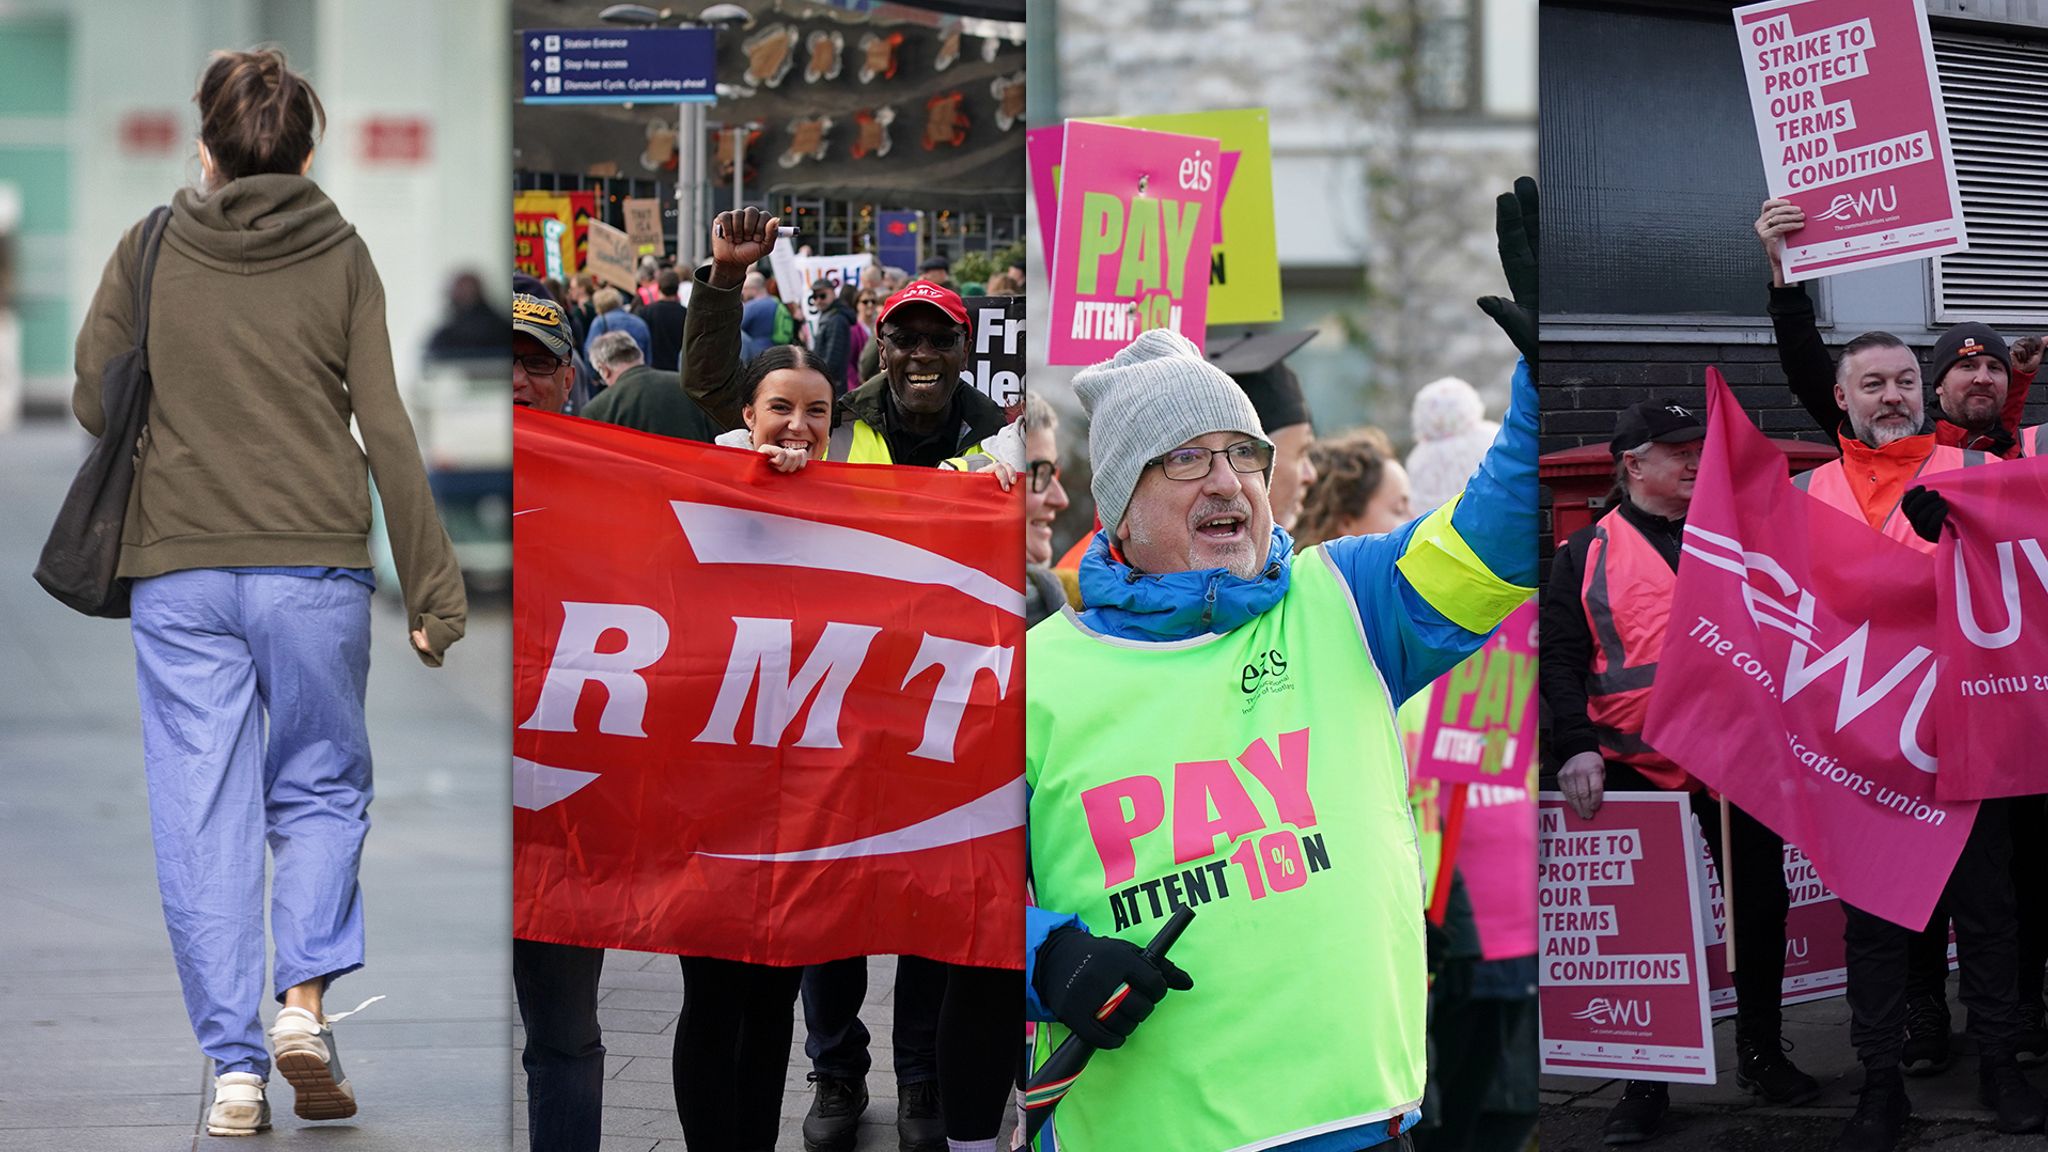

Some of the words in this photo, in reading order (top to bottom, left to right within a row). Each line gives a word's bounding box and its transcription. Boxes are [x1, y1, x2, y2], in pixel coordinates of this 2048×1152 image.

[563, 37, 592, 49] Station
[593, 37, 628, 49] Entrance
[1752, 21, 1785, 46] ON
[1758, 34, 1831, 71] STRIKE
[1837, 26, 1865, 50] TO
[564, 78, 602, 90] Dismount
[628, 78, 650, 91] Cycle
[651, 78, 681, 91] parking
[682, 77, 707, 89] ahead
[1765, 52, 1859, 95] PROTECT
[1770, 90, 1816, 118] OUR
[1775, 107, 1846, 142] TERMS
[1782, 137, 1828, 166] AND
[1788, 137, 1924, 188] CONDITIONS
[1178, 150, 1212, 192] eis
[1829, 185, 1898, 221] CWU
[1076, 192, 1202, 300] PAY
[518, 601, 1015, 763] RMT
[1241, 650, 1287, 694] eis
[1442, 648, 1539, 735] PAY
[1689, 616, 1734, 656] The
[1876, 787, 1946, 826] union
[1081, 727, 1317, 889] PAY
[1606, 835, 1634, 855] TO
[1539, 887, 1583, 907] OUR
[1542, 911, 1610, 932] TERMS
[1545, 937, 1590, 956] AND
[1550, 959, 1682, 981] CONDITIONS
[1587, 997, 1652, 1027] CWU
